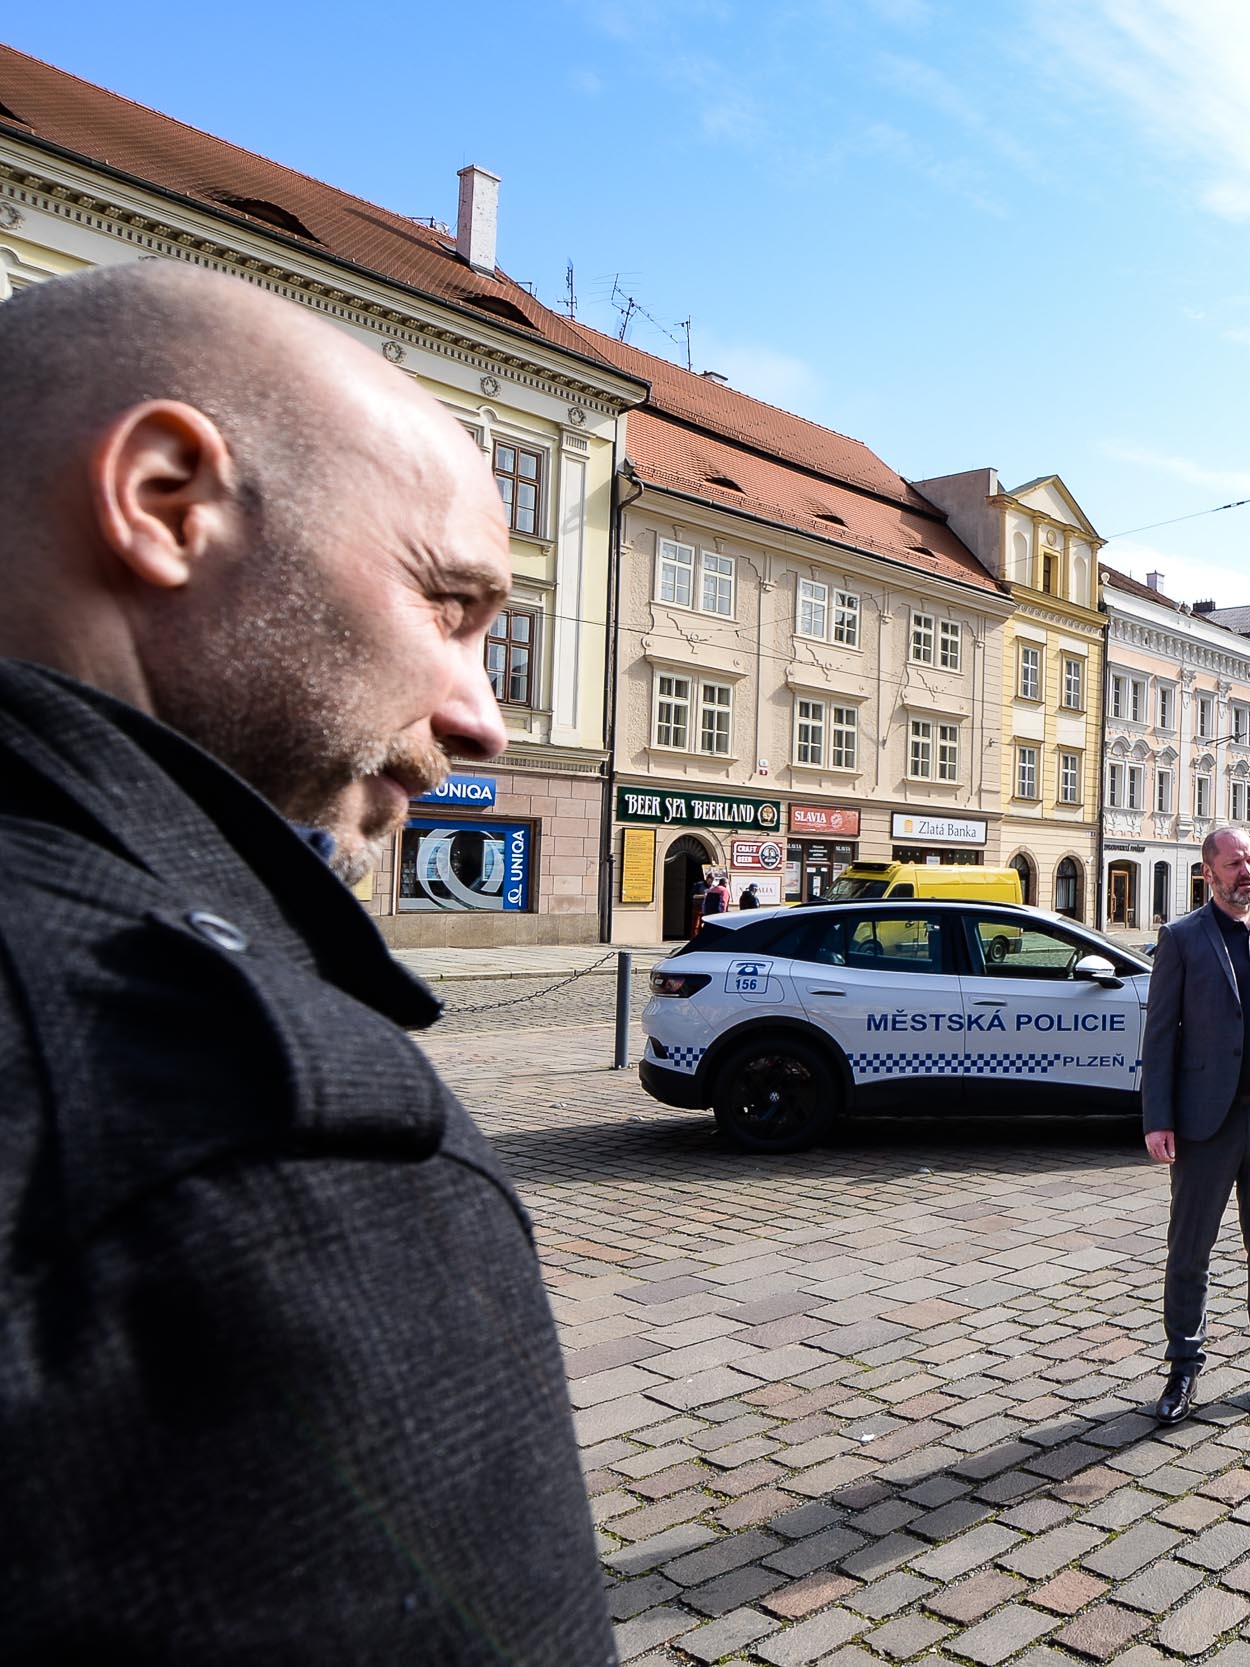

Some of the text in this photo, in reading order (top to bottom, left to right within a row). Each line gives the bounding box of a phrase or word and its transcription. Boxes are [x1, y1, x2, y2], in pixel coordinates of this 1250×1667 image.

[436, 783, 493, 800] UNIQA
[625, 794, 754, 822] BEER SPA BEERLAND
[794, 811, 827, 823] SLAVIA
[918, 820, 977, 838] Zlatá Banka
[511, 830, 525, 881] UNIQA
[737, 845, 758, 853] CRAFT
[736, 979, 757, 990] 156
[866, 1009, 1126, 1032] MĚSTSKÁ POLICIE
[1062, 1053, 1125, 1067] PLZEŇ
